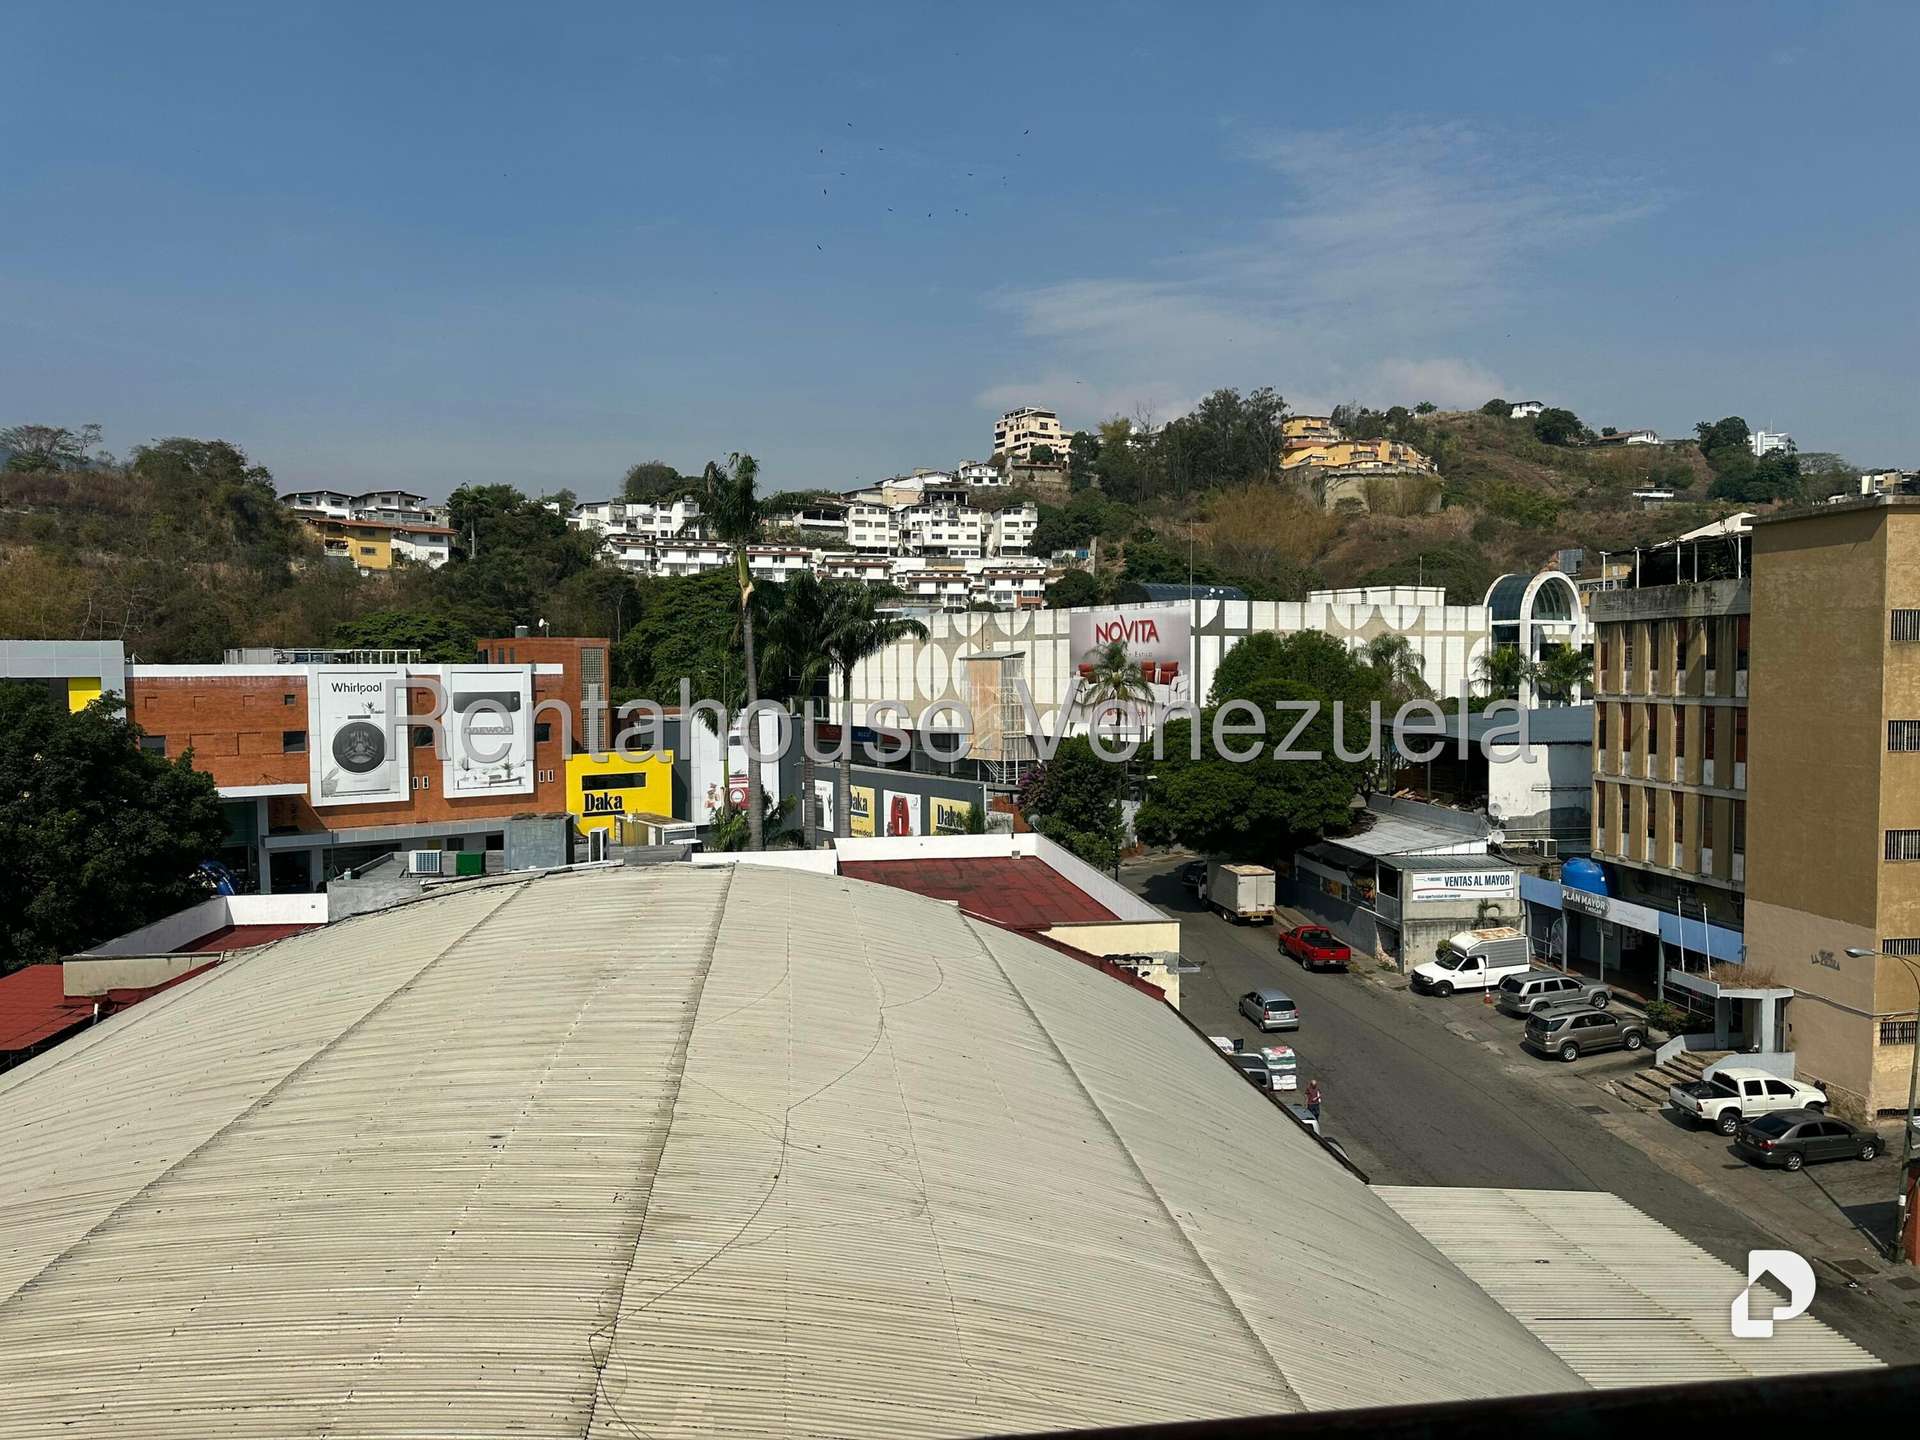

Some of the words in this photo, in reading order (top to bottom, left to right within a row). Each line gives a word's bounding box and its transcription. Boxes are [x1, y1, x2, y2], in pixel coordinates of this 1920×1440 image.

[1095, 615, 1160, 644] NOVITA
[331, 682, 382, 694] Whirlpool
[464, 726, 512, 734] DAEWOO
[584, 792, 623, 812] Daka
[850, 792, 868, 812] aka
[1444, 876, 1473, 887] VENTAS
[1473, 876, 1484, 886] AL
[1485, 875, 1510, 886] MAYOR
[1562, 890, 1581, 903] PLAN
[1581, 895, 1606, 910] MAYOR
